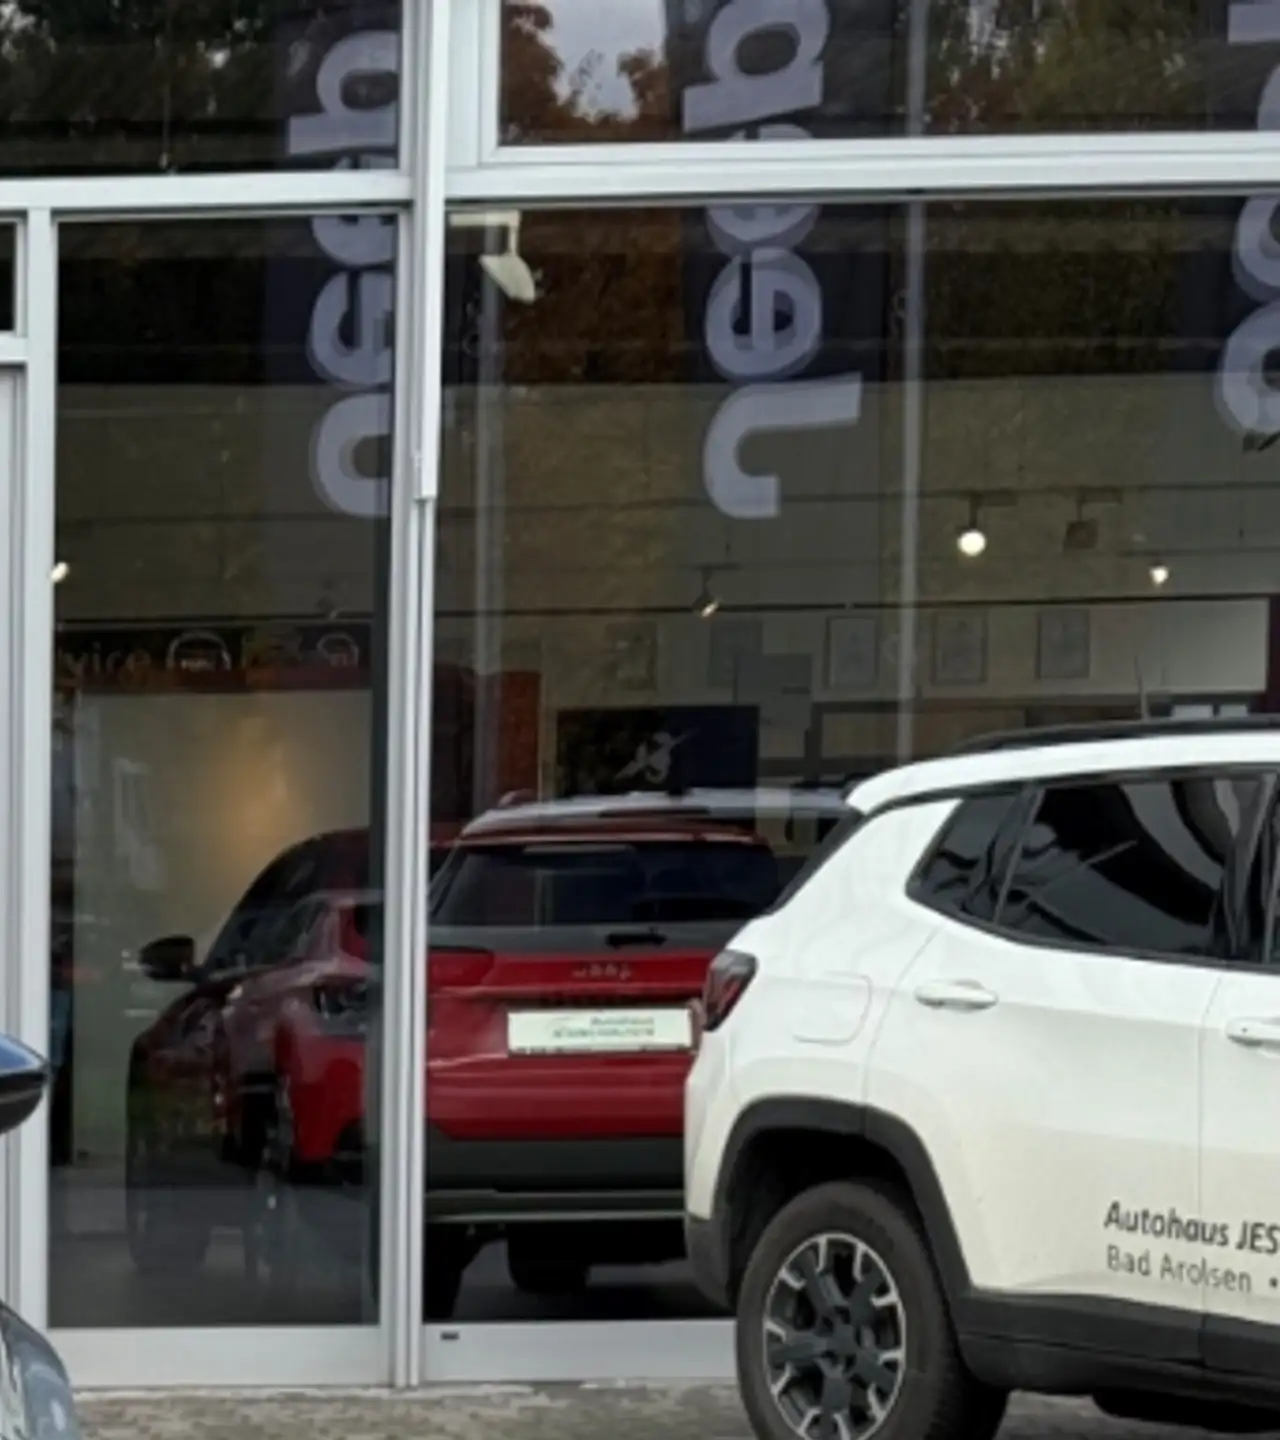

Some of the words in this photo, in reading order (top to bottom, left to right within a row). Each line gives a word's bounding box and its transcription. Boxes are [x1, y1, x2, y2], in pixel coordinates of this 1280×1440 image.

[1104, 1200, 1229, 1248] Autohaus
[1107, 1244, 1152, 1277] Bad
[1160, 1252, 1252, 1293] Arolsen
